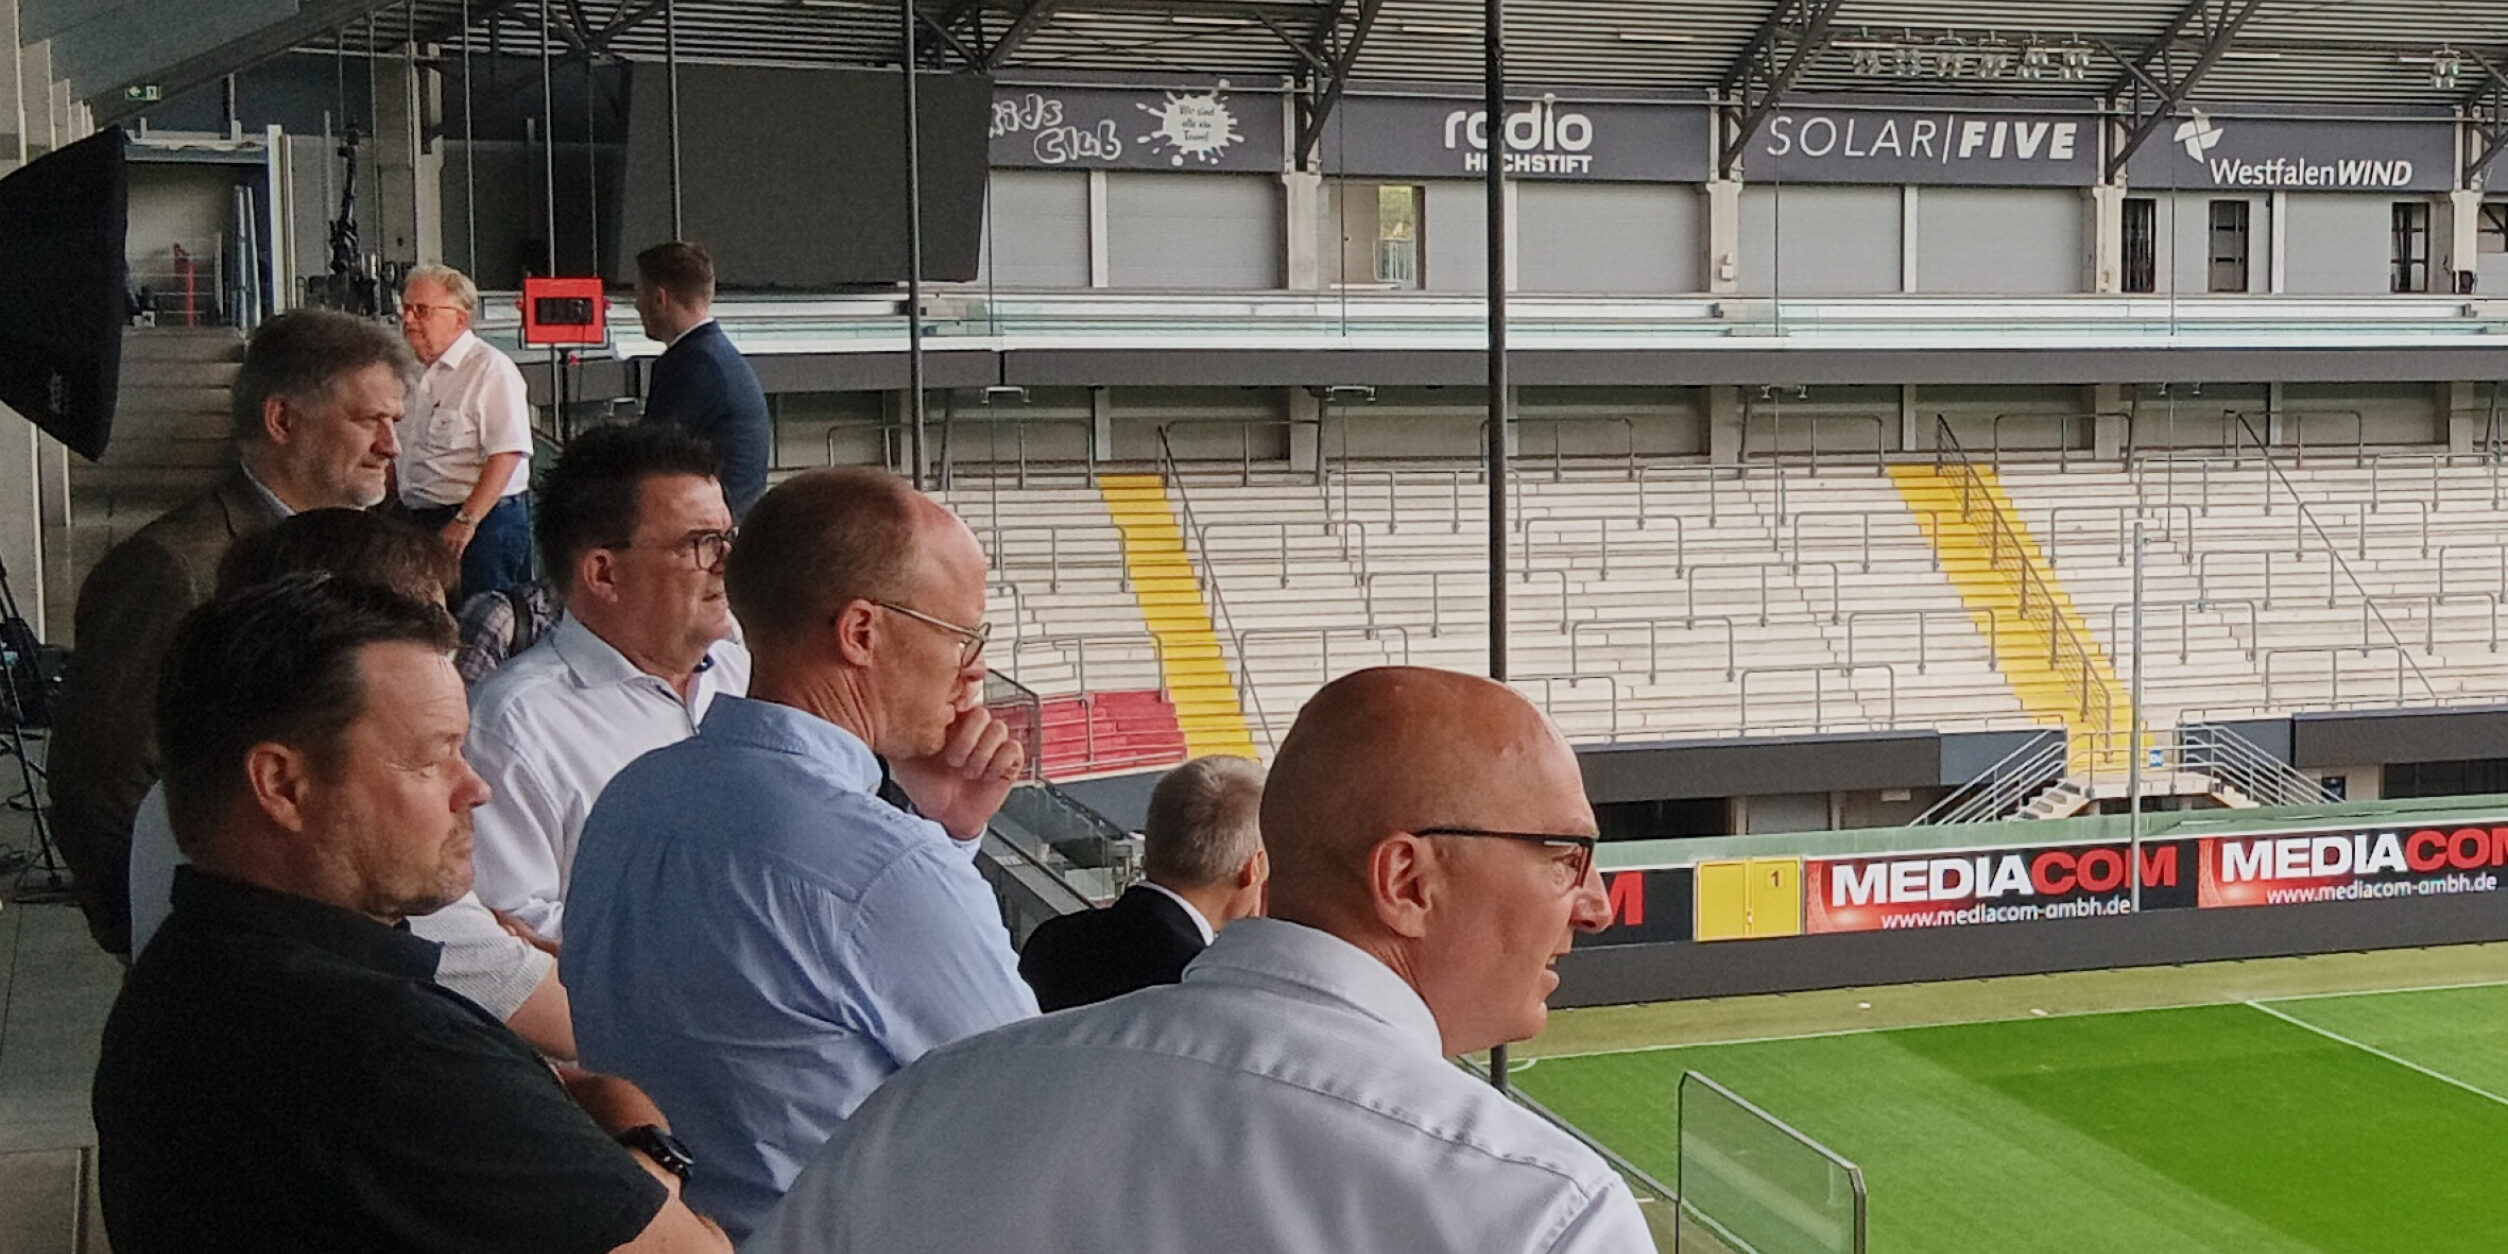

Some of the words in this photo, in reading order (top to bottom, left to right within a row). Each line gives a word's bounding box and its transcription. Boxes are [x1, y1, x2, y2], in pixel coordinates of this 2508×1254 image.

[1033, 120, 1122, 164] Club
[2210, 157, 2413, 186] WestfalenWIND
[1770, 870, 1780, 888] 1
[1832, 846, 2177, 908] MEDIACOM
